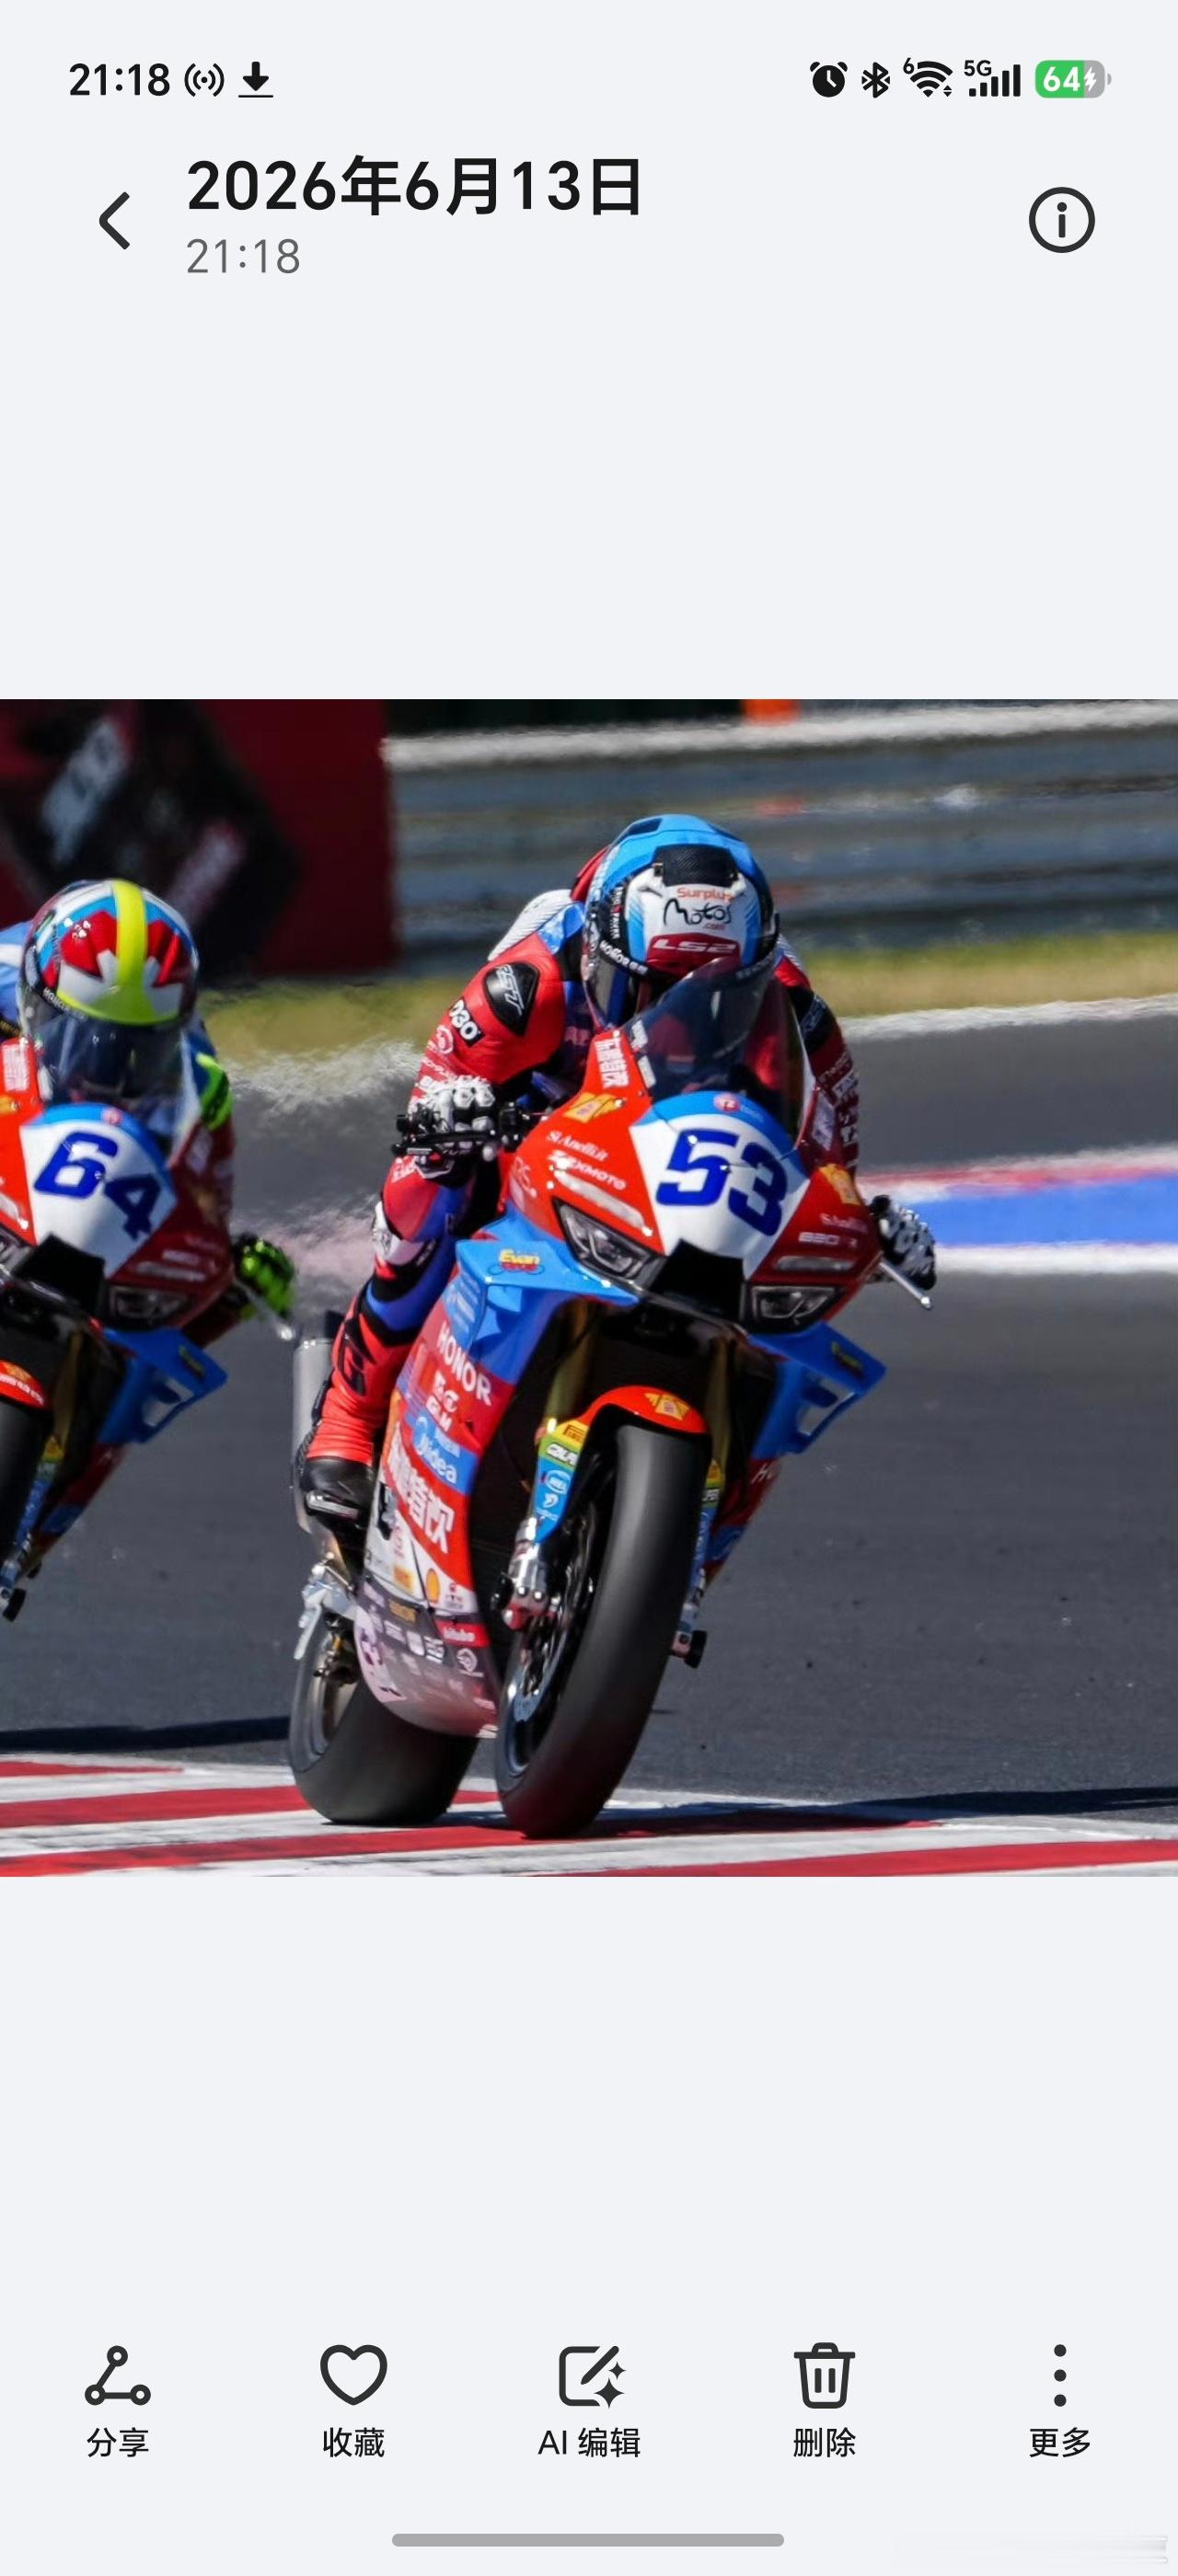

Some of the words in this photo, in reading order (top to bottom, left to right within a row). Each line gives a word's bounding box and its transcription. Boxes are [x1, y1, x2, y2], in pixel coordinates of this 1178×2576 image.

[70, 63, 170, 96] 21:18
[903, 57, 916, 75] 6
[964, 60, 992, 76] 5G
[1044, 67, 1080, 91] 64
[188, 155, 640, 217] 2026年6月13日
[187, 238, 300, 274] 21:18
[652, 938, 738, 953] LS2
[33, 1131, 161, 1241] 64
[655, 1128, 788, 1236] 53
[437, 1319, 491, 1407] HONOR
[87, 2427, 149, 2458] 分享
[322, 2427, 385, 2458] 收藏
[537, 2430, 568, 2455] AI
[578, 2427, 641, 2458] 编辑
[793, 2427, 856, 2458] 删除
[1028, 2427, 1091, 2458] 更多
